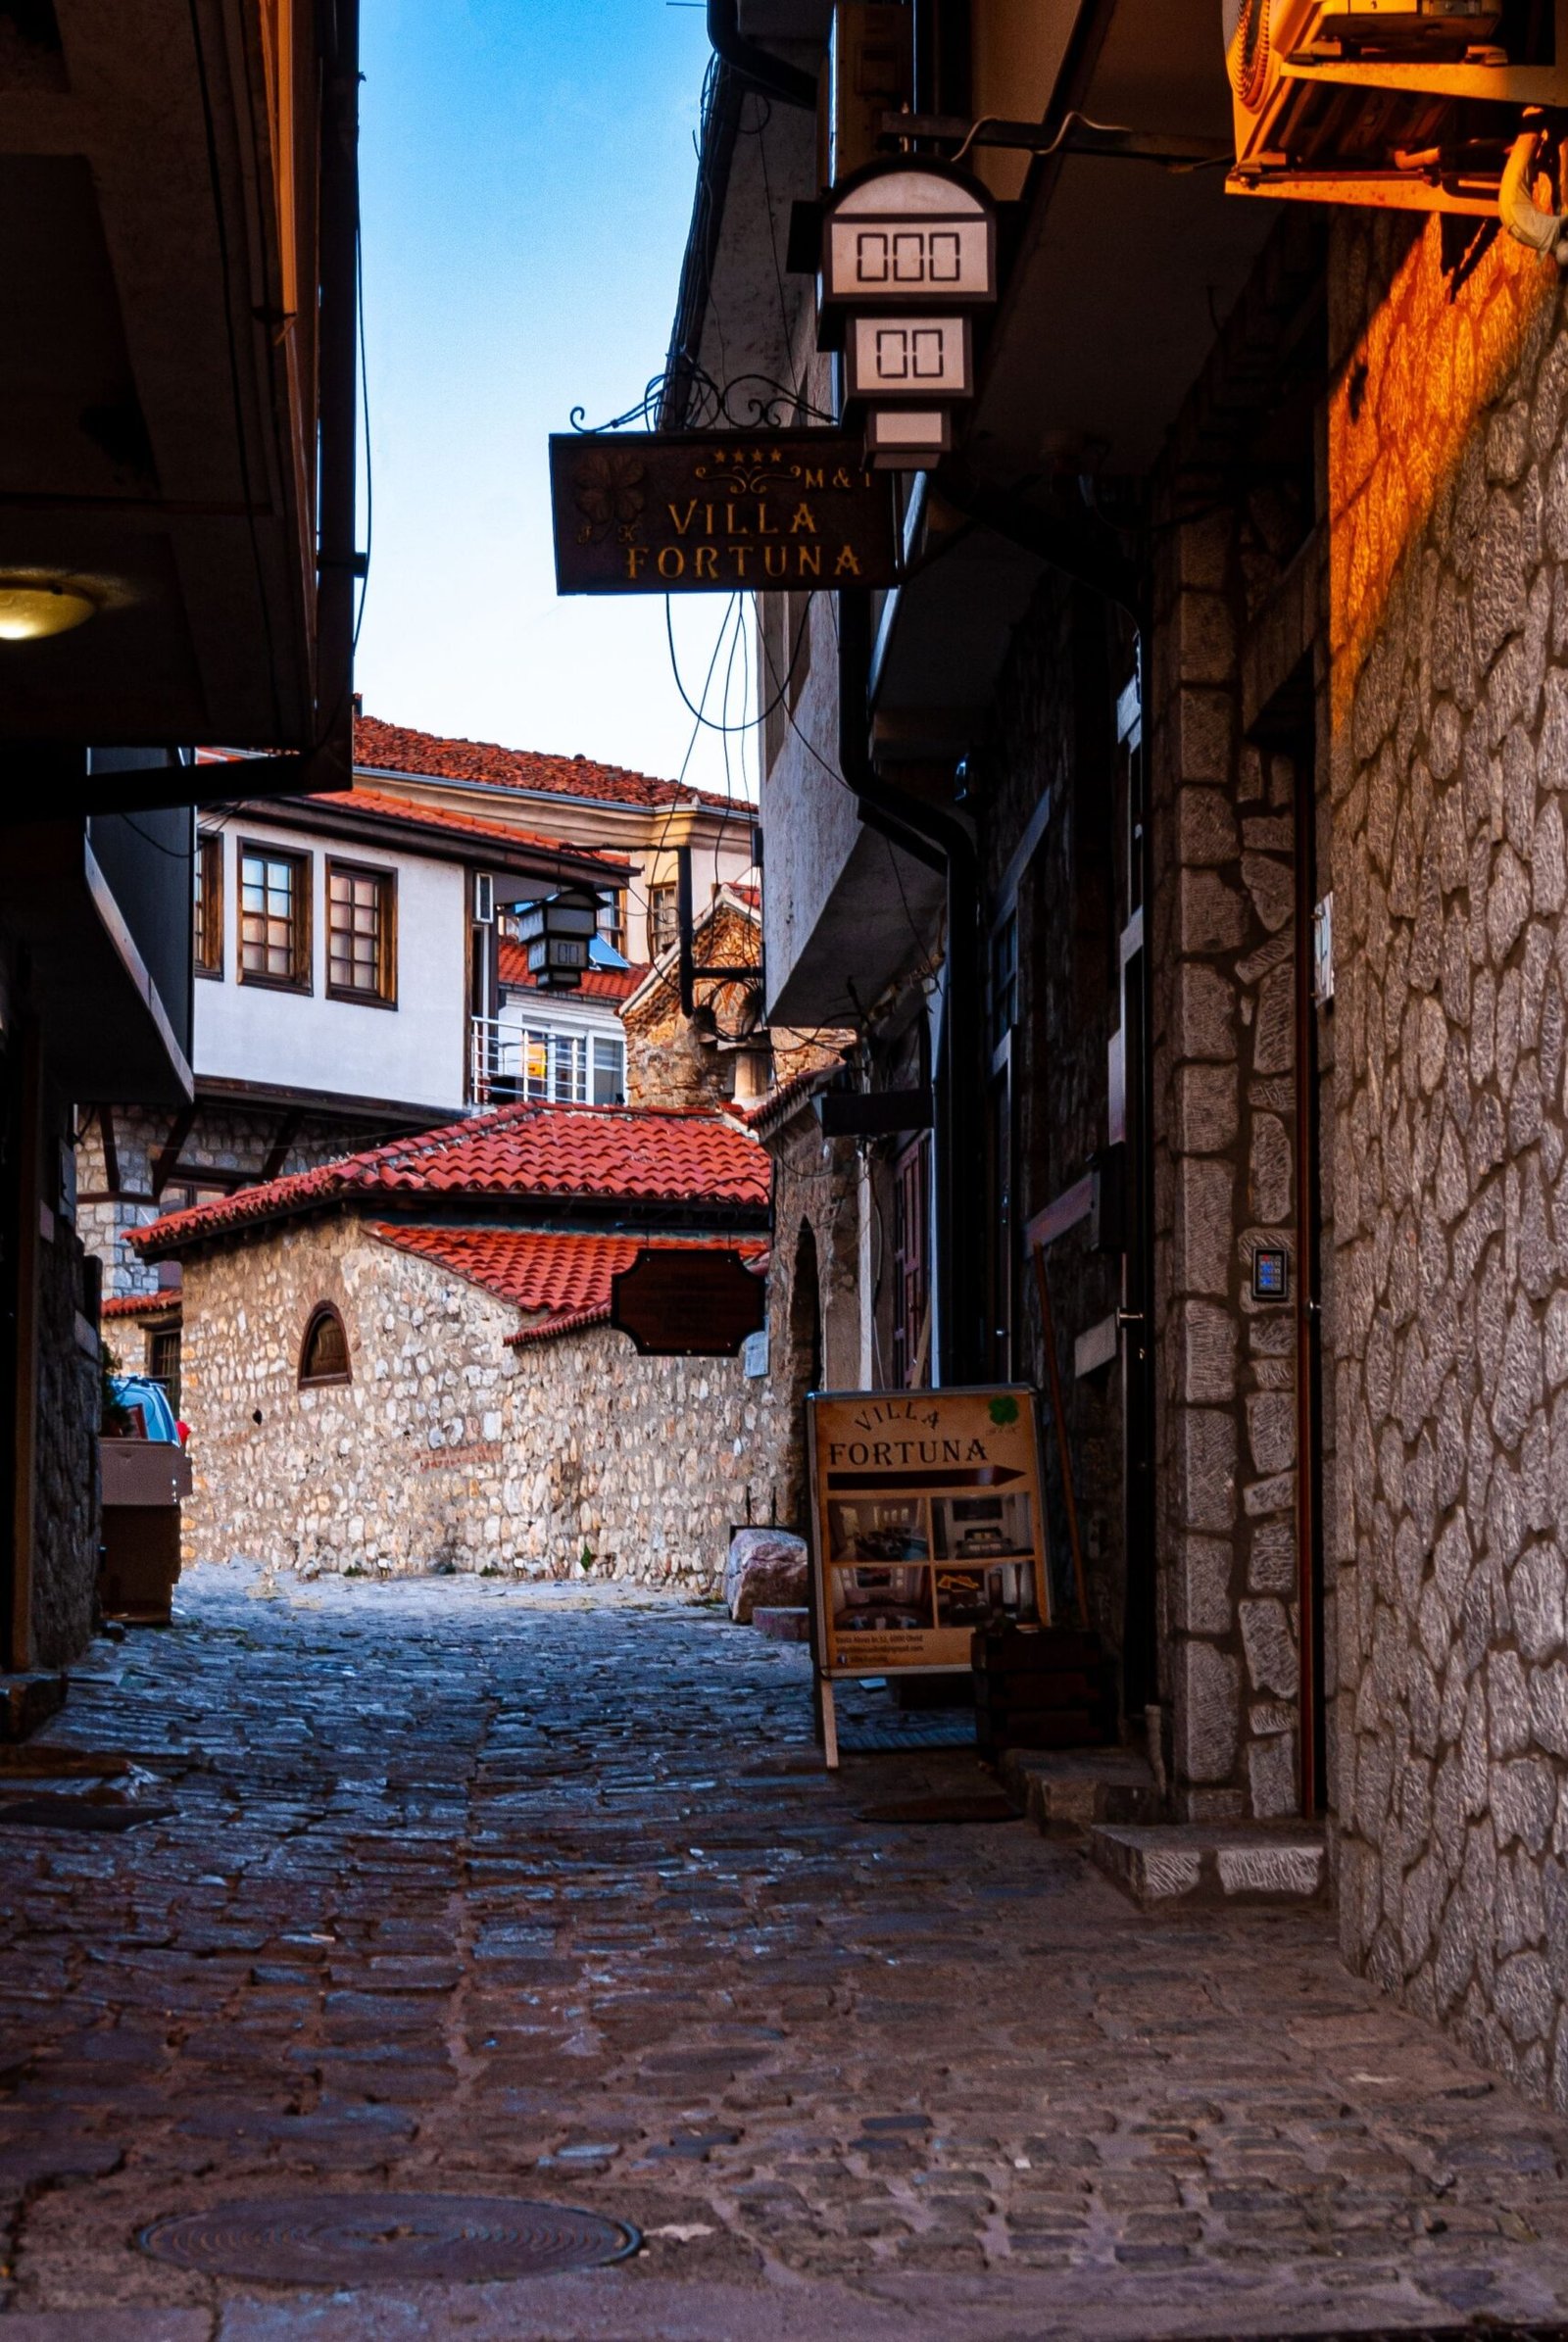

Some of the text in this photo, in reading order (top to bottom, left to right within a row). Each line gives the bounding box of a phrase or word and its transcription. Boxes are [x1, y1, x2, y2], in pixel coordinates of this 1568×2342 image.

[805, 467, 823, 489] M
[832, 465, 852, 488] &
[667, 498, 818, 536] VILLA
[625, 544, 863, 580] FORTUNA
[855, 1401, 941, 1432] VILLA
[829, 1439, 988, 1466] FORTUNA
